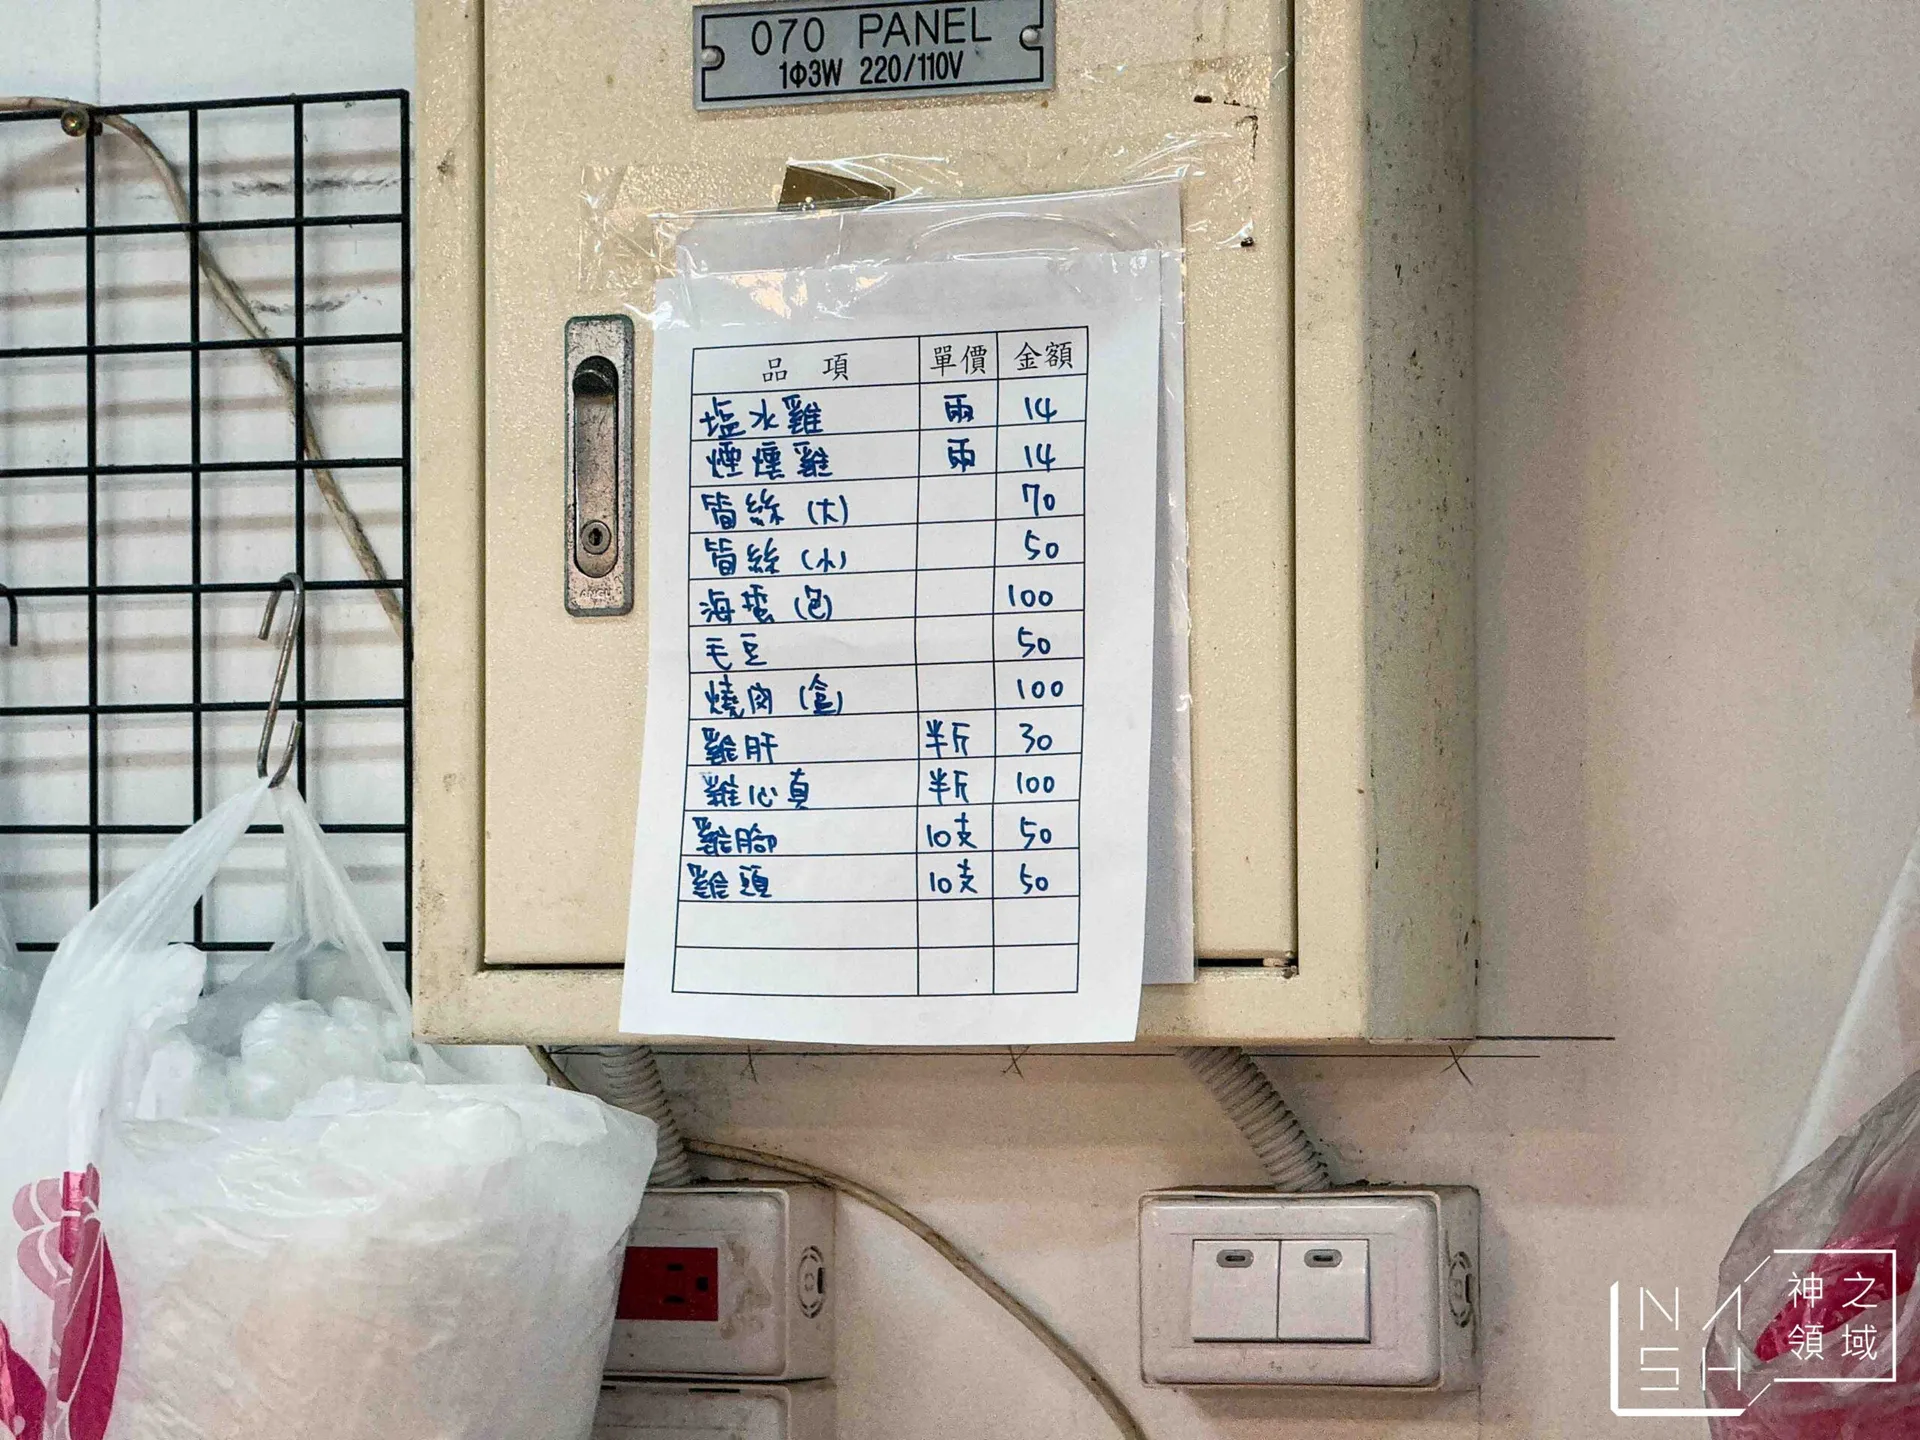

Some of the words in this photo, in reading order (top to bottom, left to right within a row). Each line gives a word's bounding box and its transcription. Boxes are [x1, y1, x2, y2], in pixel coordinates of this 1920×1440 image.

[751, 17, 825, 56] 070
[859, 6, 992, 48] PANEL
[860, 51, 964, 84] 220/110V
[930, 344, 987, 377] 單價
[1014, 341, 1072, 371] 金額
[1024, 397, 1057, 423] 14
[1024, 443, 1057, 471] 14
[1022, 484, 1056, 516] 70
[1025, 530, 1059, 560] 50
[1008, 584, 1053, 607] 100
[706, 633, 768, 670] 毛豆
[1018, 627, 1051, 656] 50
[1017, 679, 1063, 699] 100
[925, 719, 970, 757] 半斤
[1019, 724, 1052, 752] 30
[928, 768, 969, 805] 半斤
[1017, 772, 1055, 794] 100
[926, 812, 977, 849] 10支
[1021, 817, 1051, 849] 50
[929, 859, 977, 893] 10支
[1021, 864, 1048, 894] 50
